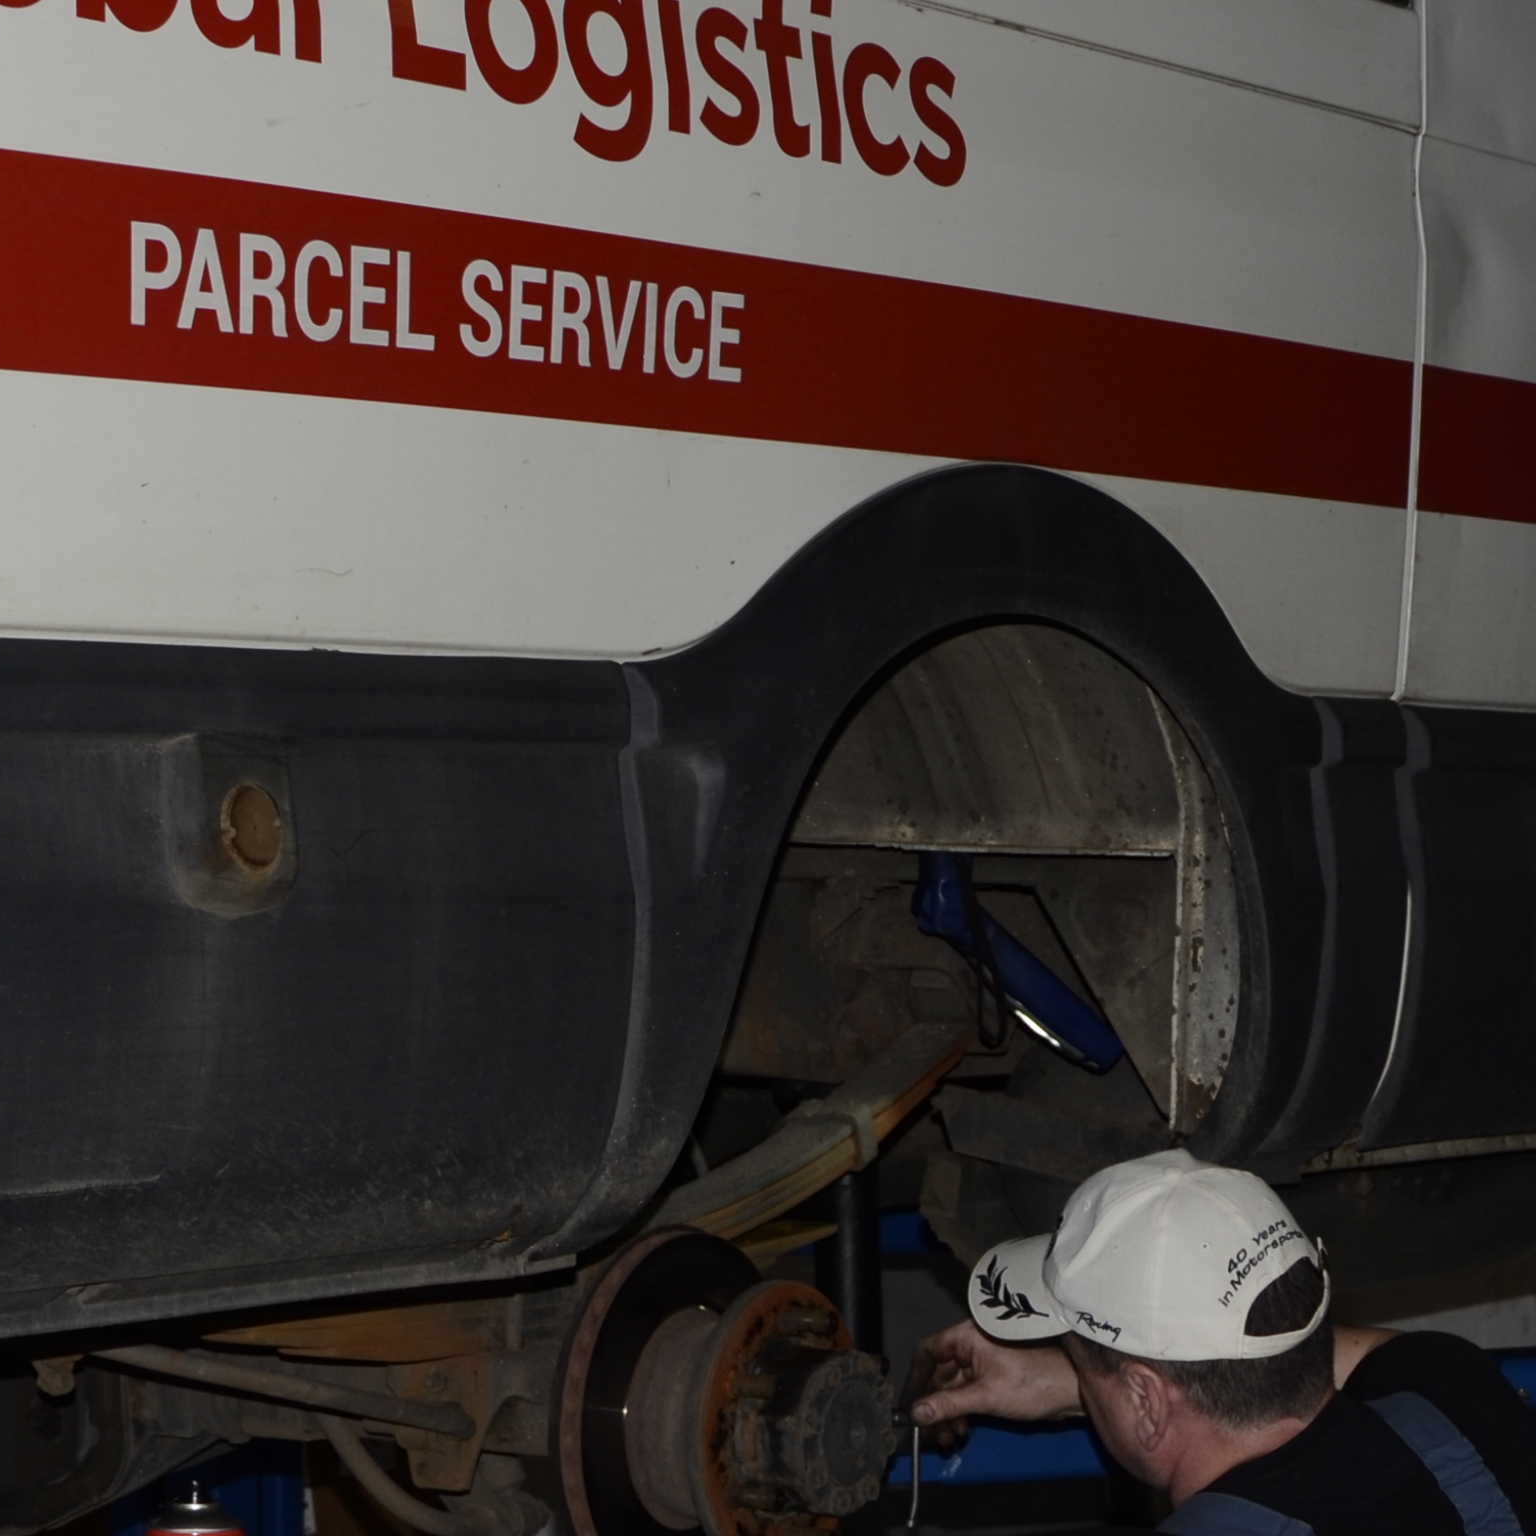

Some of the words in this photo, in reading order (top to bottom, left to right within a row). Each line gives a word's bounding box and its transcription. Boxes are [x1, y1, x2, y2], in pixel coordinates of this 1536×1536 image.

[130, 219, 435, 352] PARCEL
[459, 258, 745, 384] SERVICE
[1227, 1248, 1248, 1274] 40
[1252, 1219, 1288, 1246] Years
[1218, 1290, 1234, 1307] in
[1075, 1311, 1122, 1343] Racing
